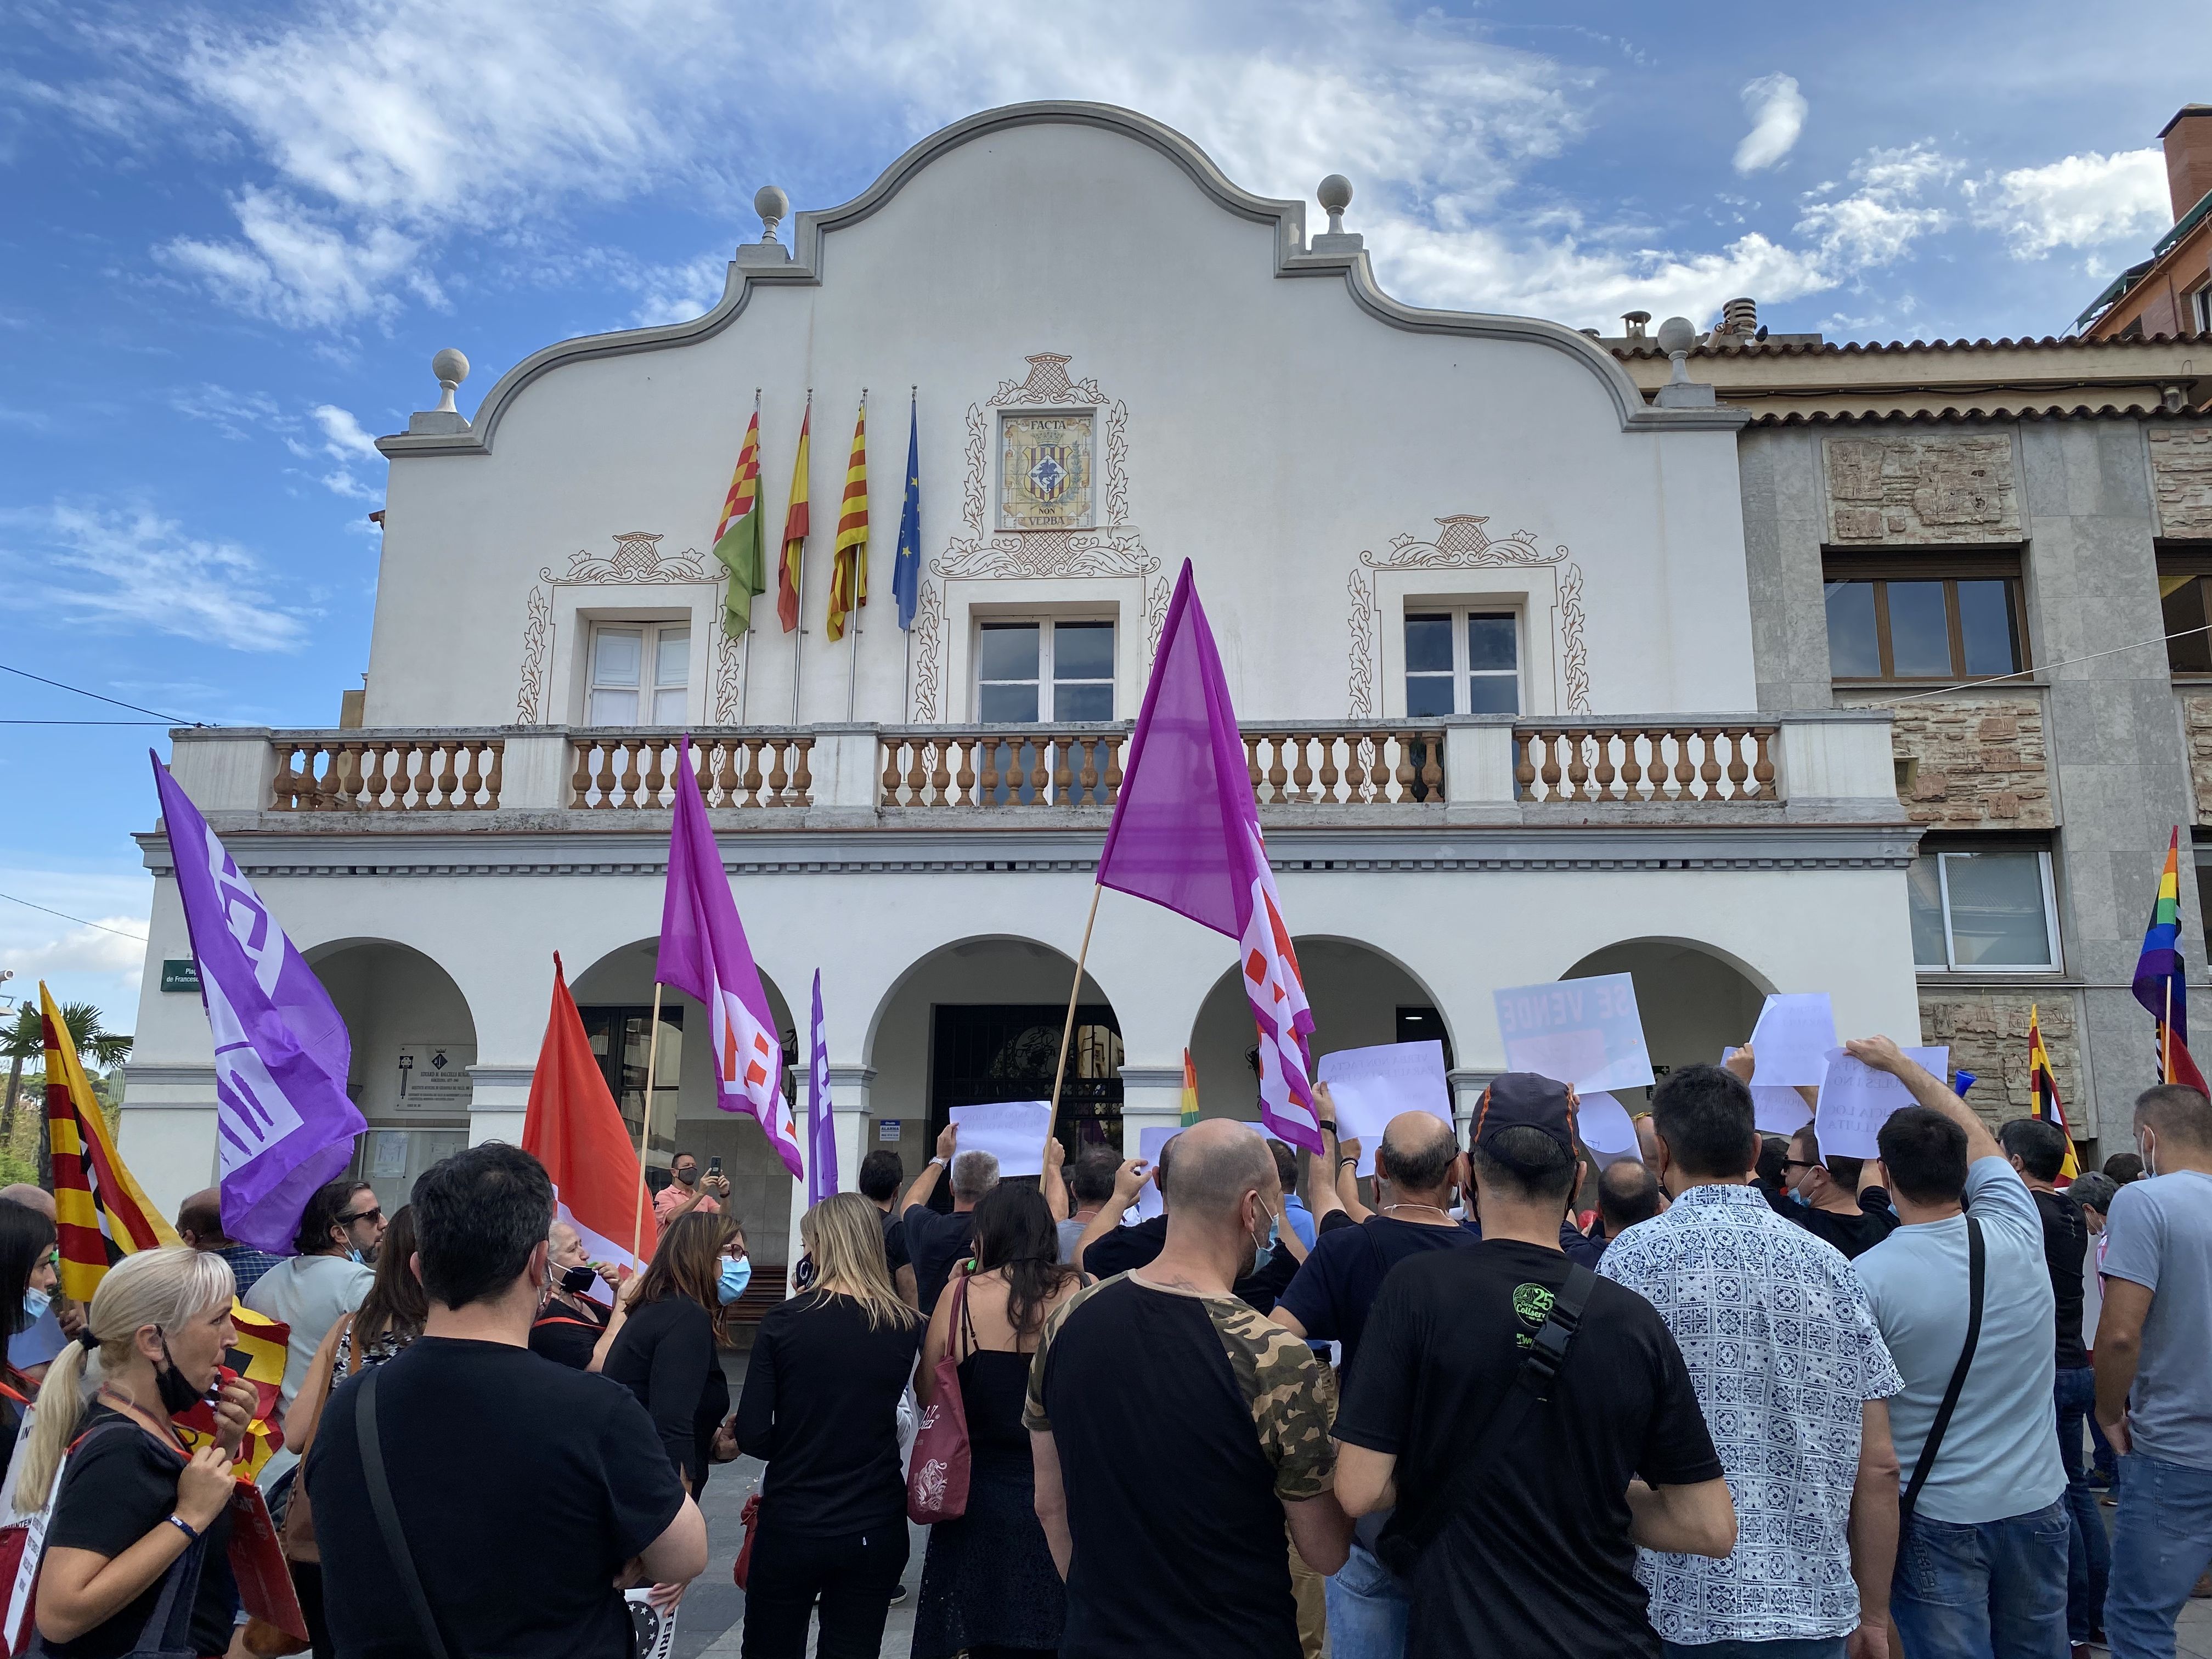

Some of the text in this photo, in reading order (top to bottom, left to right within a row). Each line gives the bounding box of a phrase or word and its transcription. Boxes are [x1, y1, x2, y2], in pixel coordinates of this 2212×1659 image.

[1031, 421, 1066, 430] FACTA
[1029, 516, 1065, 526] VERBA
[1533, 1288, 1554, 1311] 25
